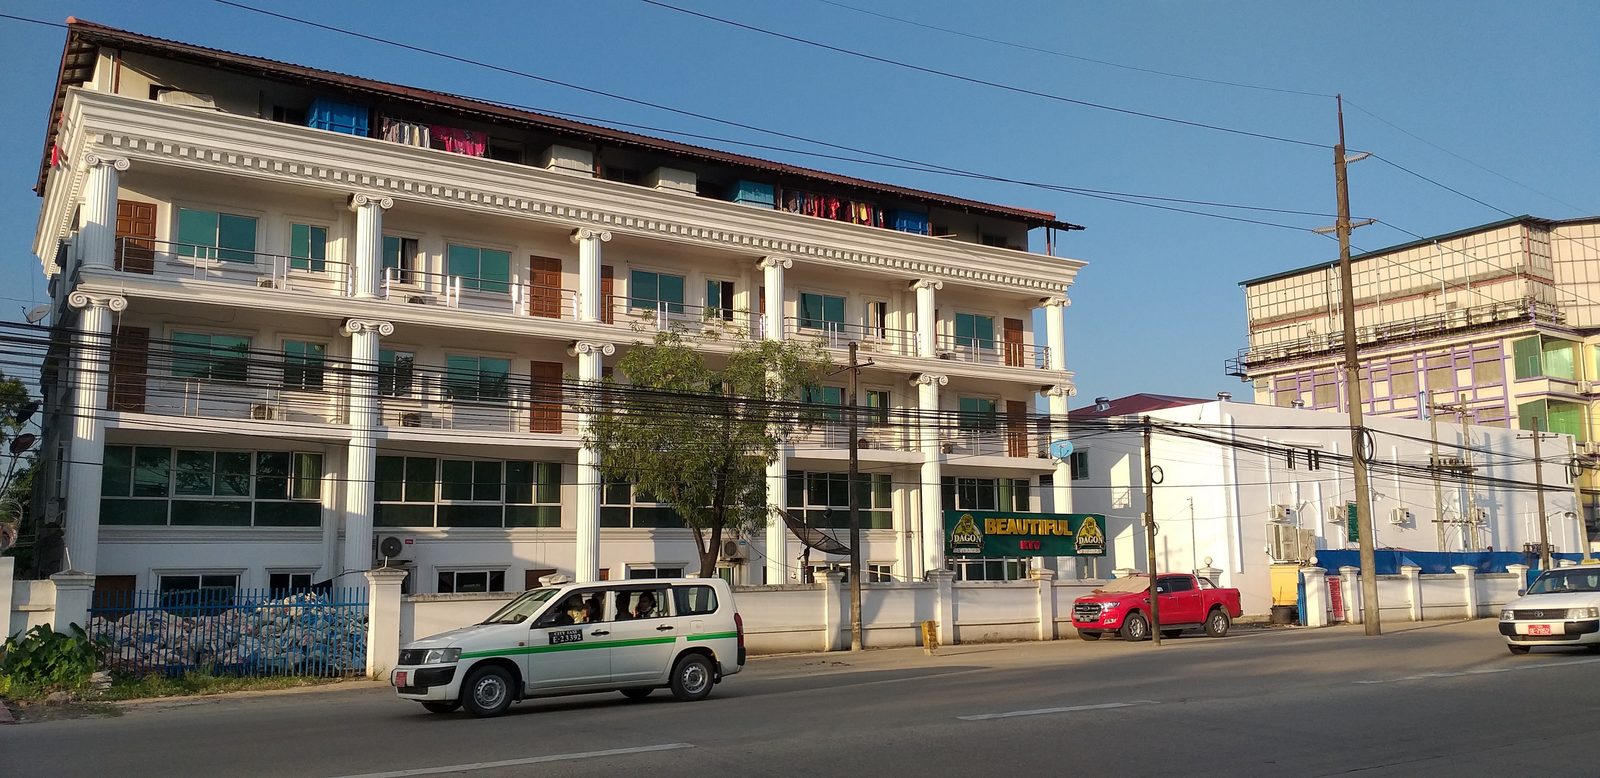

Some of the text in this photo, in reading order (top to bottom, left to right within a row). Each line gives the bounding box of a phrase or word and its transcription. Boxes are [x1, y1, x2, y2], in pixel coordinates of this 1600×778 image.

[984, 518, 1073, 536] BEAUTIFUL
[954, 534, 982, 543] DAGON
[1078, 536, 1103, 545] DAGON
[1020, 540, 1041, 550] KTV
[553, 633, 582, 643] E-23392
